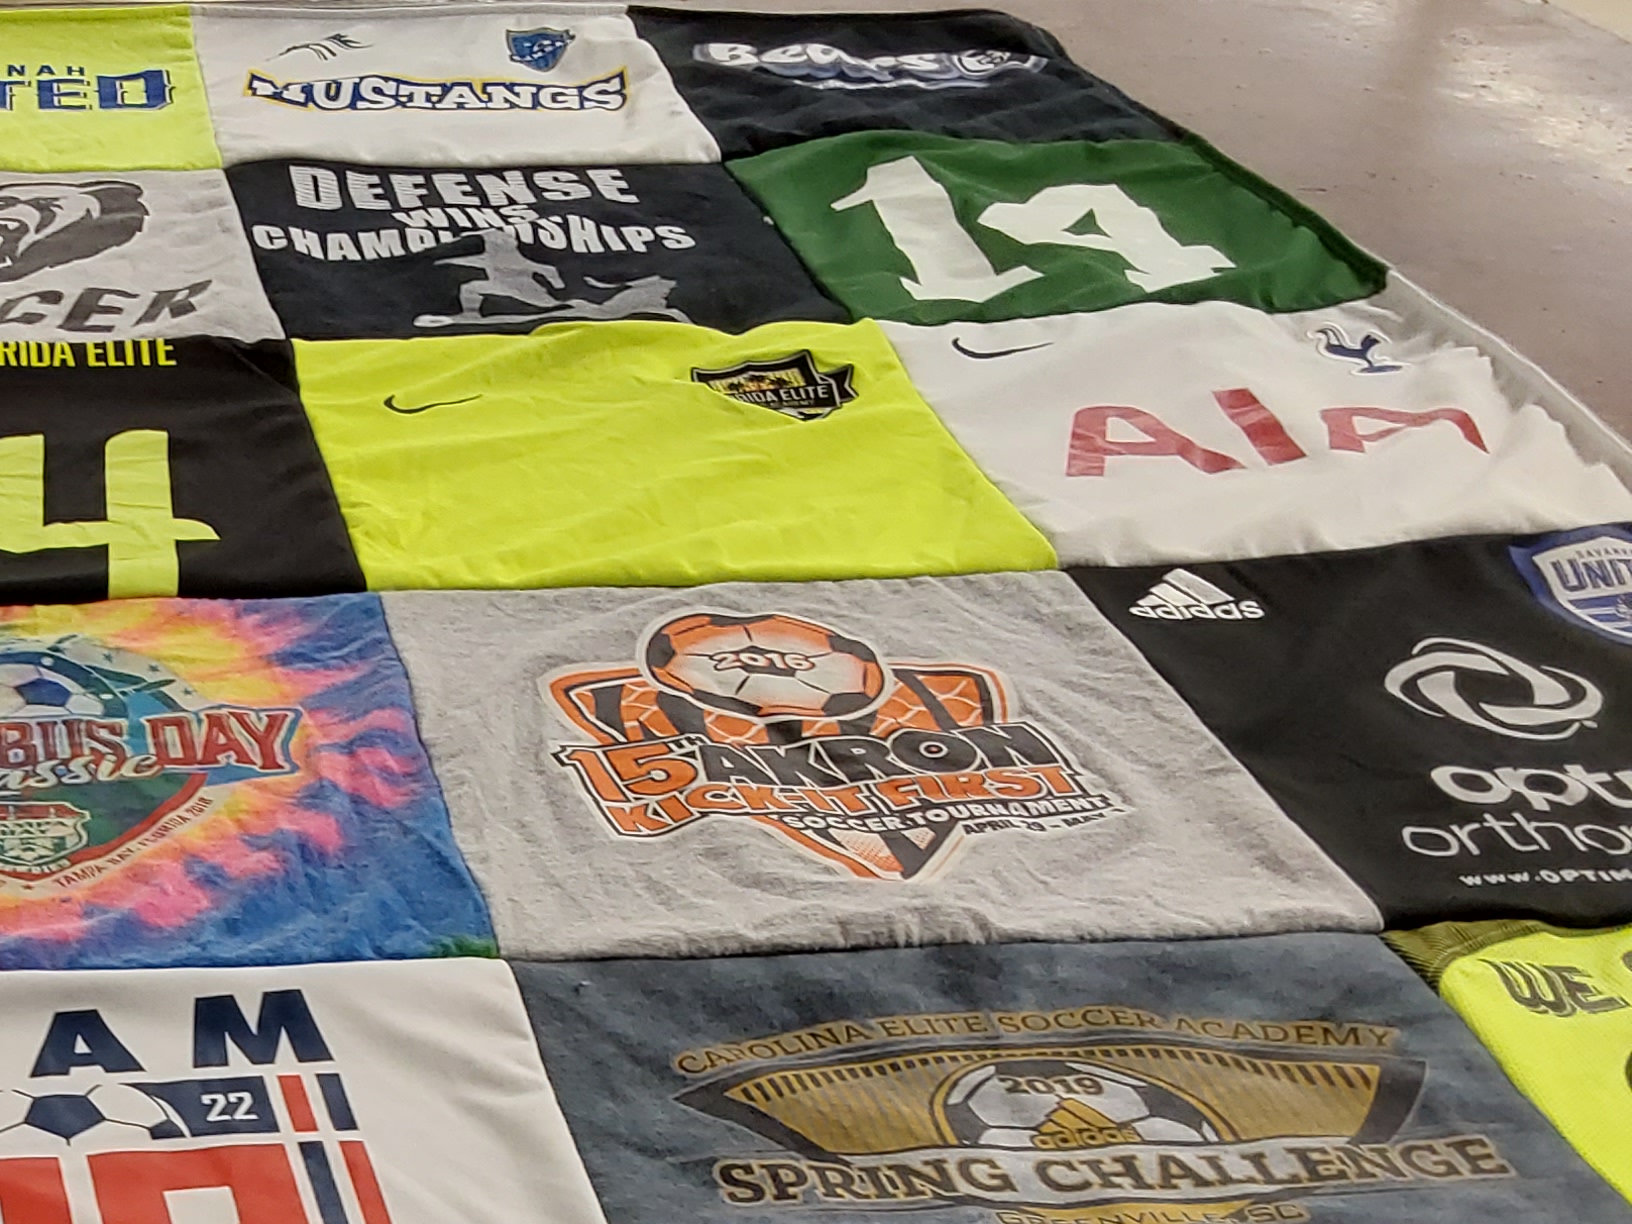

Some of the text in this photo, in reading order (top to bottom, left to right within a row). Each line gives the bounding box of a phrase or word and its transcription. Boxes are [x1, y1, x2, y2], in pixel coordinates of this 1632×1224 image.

[248, 68, 628, 111] MUSTANGS
[288, 165, 639, 211] DEFENSE
[392, 205, 539, 230] WINS
[831, 156, 1237, 302] 14
[252, 214, 695, 261] CHAMPINSHIPS
[86, 339, 178, 368] ELITE
[779, 385, 830, 402] ELITE
[1575, 547, 1632, 559] SAVAN
[1129, 599, 1264, 620] adidas
[710, 652, 816, 672] 2016
[140, 707, 302, 773] DAY
[696, 724, 1063, 788] AKRON
[882, 765, 1082, 808] FIRST
[784, 795, 1110, 833] SOCCER TOURNAMENT
[962, 818, 1021, 835] APRIL
[1402, 812, 1632, 857] ortho
[53, 864, 107, 888] TAMPA
[1477, 959, 1630, 1018] WE
[677, 1008, 1394, 1075] CAROLINA ELITE SOCCER ACADEMY
[997, 1076, 1104, 1096] 2019
[200, 1092, 260, 1122] 22
[1031, 1125, 1141, 1150] adidas
[719, 1134, 1516, 1205] SPRING CHALLENGE
[1244, 1202, 1308, 1224] SC
